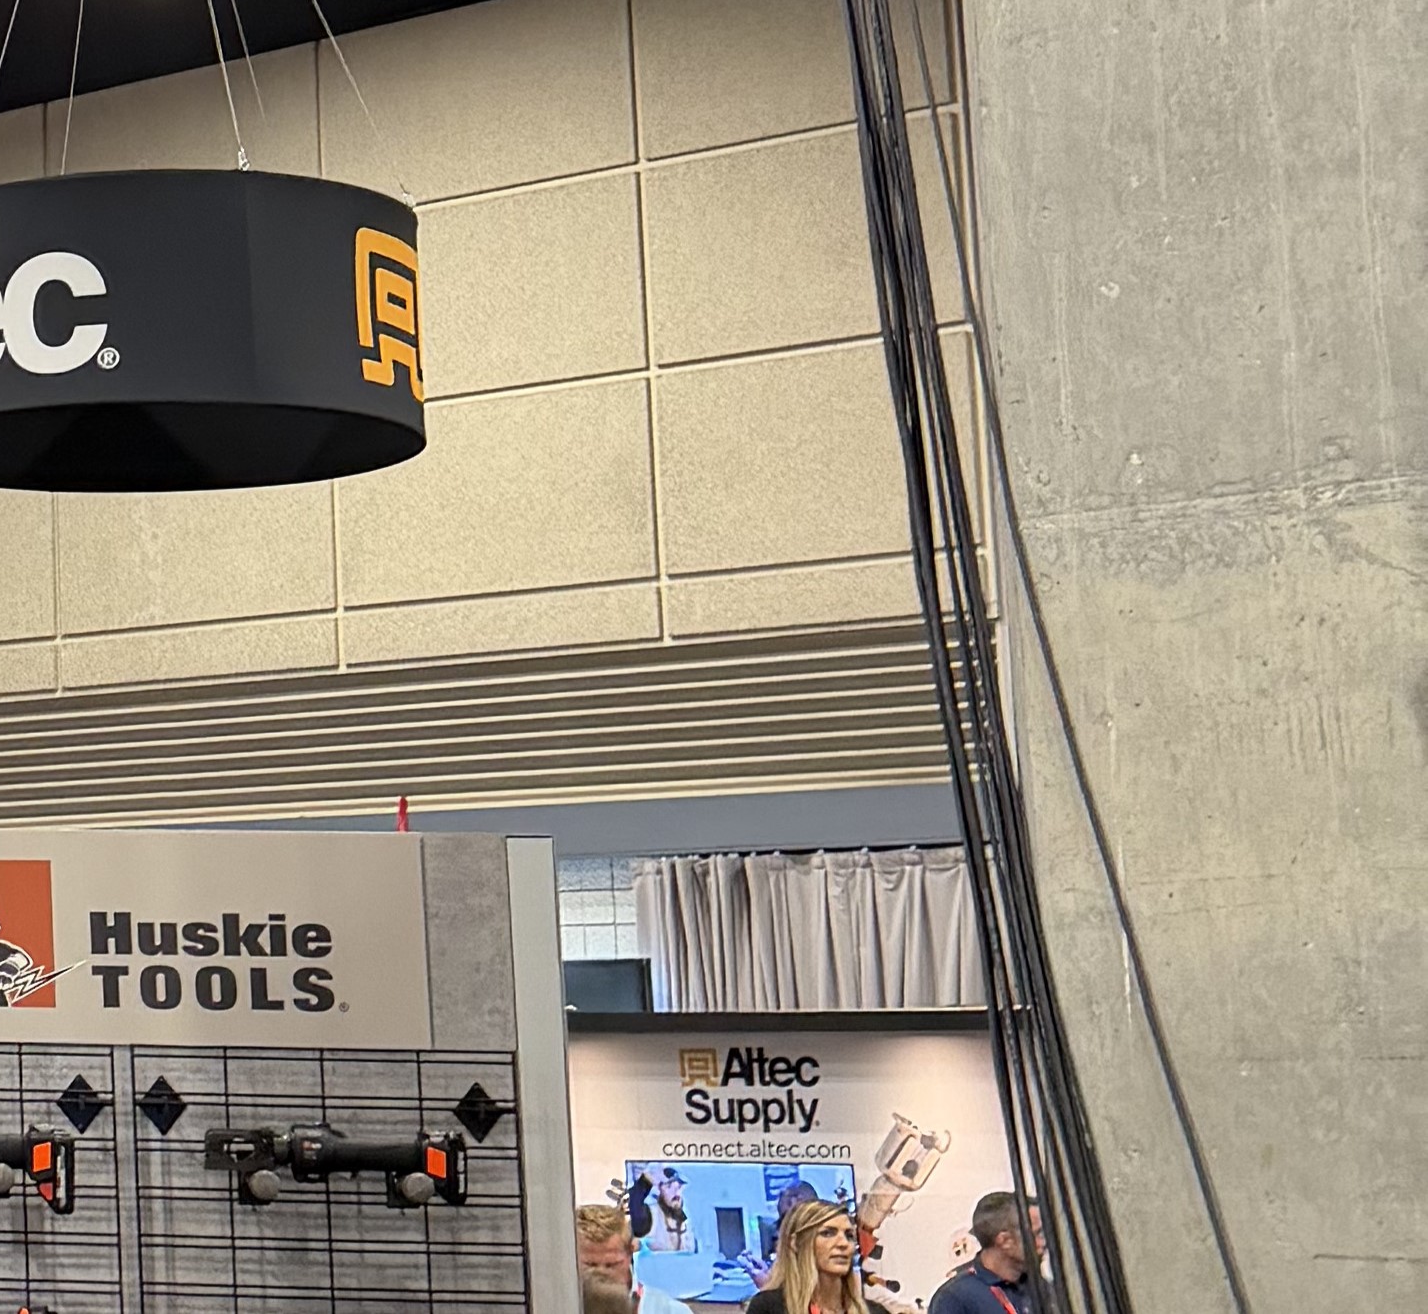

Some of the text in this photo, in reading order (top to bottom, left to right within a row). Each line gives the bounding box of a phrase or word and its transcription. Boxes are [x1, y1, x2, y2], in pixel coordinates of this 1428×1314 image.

[89, 911, 332, 958] Huskie
[720, 1047, 820, 1087] Altec
[662, 1139, 852, 1159] connect.altec.com
